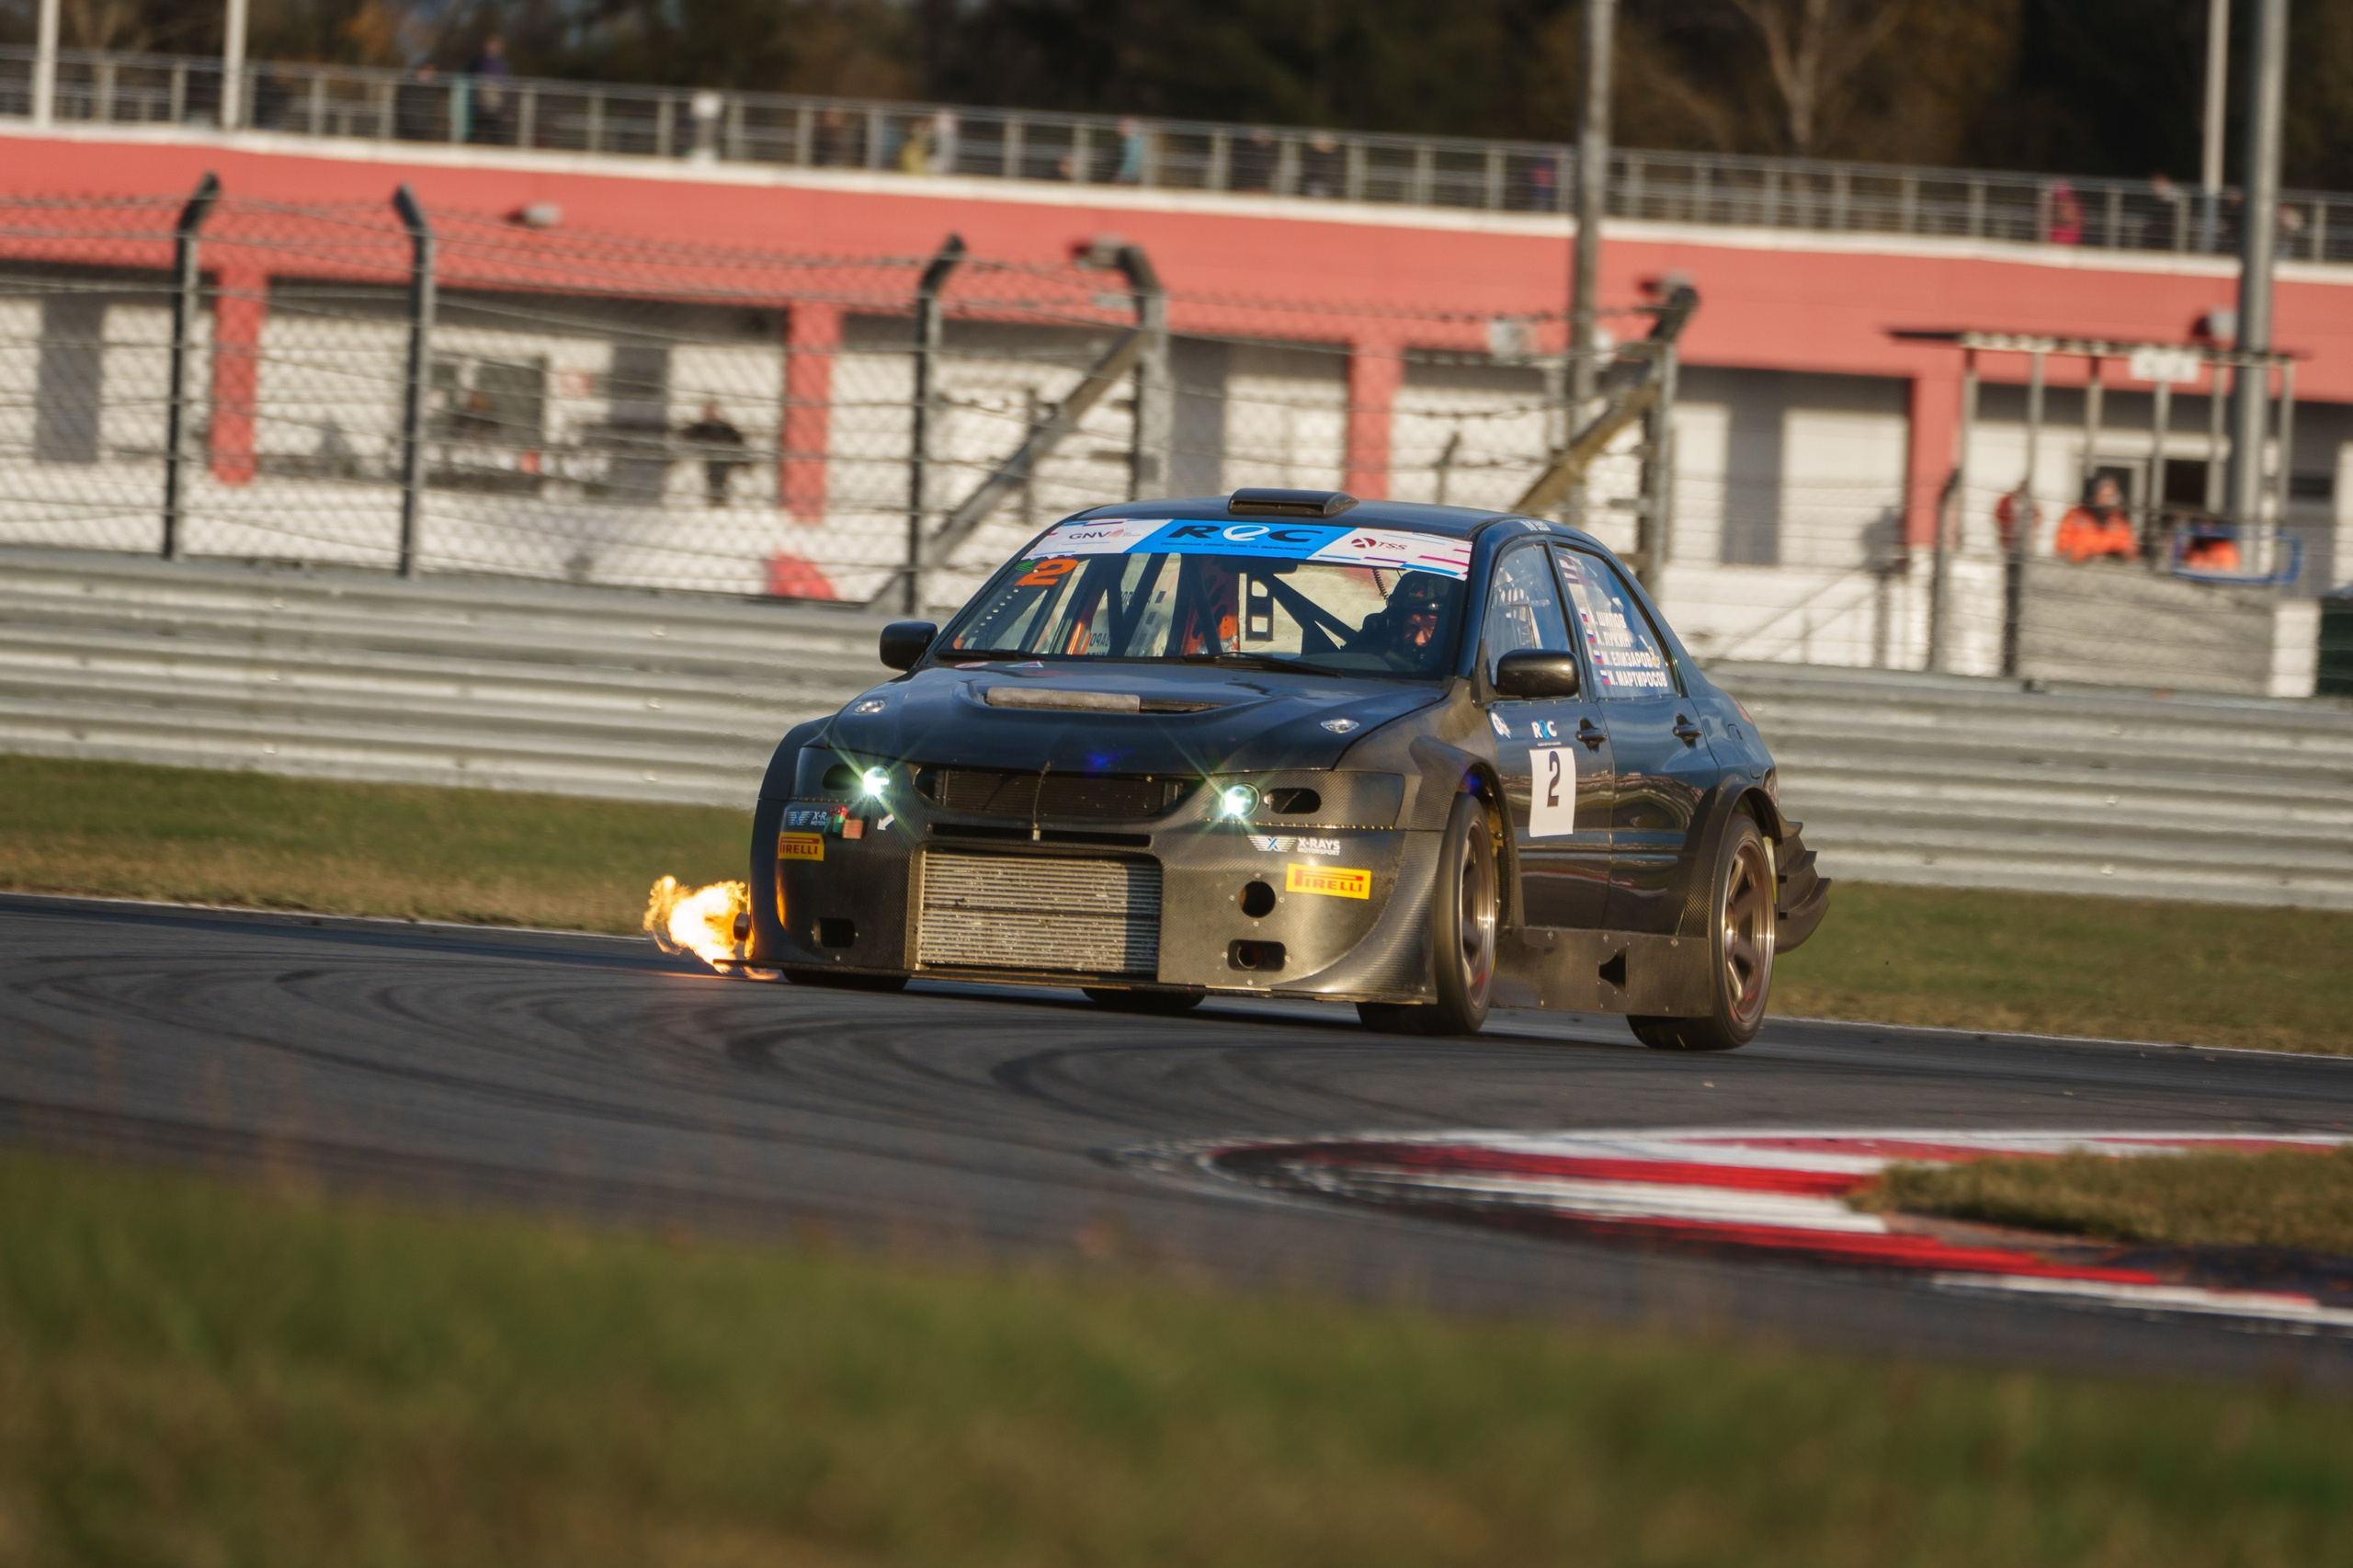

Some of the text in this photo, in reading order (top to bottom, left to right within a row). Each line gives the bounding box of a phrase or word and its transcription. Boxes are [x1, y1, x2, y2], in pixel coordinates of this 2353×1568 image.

[1069, 531, 1110, 540] GNV
[1379, 541, 1407, 551] TSS
[1015, 558, 1078, 586] 2
[1596, 611, 1627, 629] ШИПОВ
[1603, 631, 1631, 648] ЛУКИН
[1610, 651, 1653, 668] ЕЛИЗАРОВ
[1615, 671, 1668, 687] МАРТИРОСОВ
[1547, 751, 1561, 807] 2
[779, 836, 820, 855] PIRELLI
[1297, 847, 1340, 856] MOTORSPORT
[1294, 869, 1364, 892] PIRELLI
